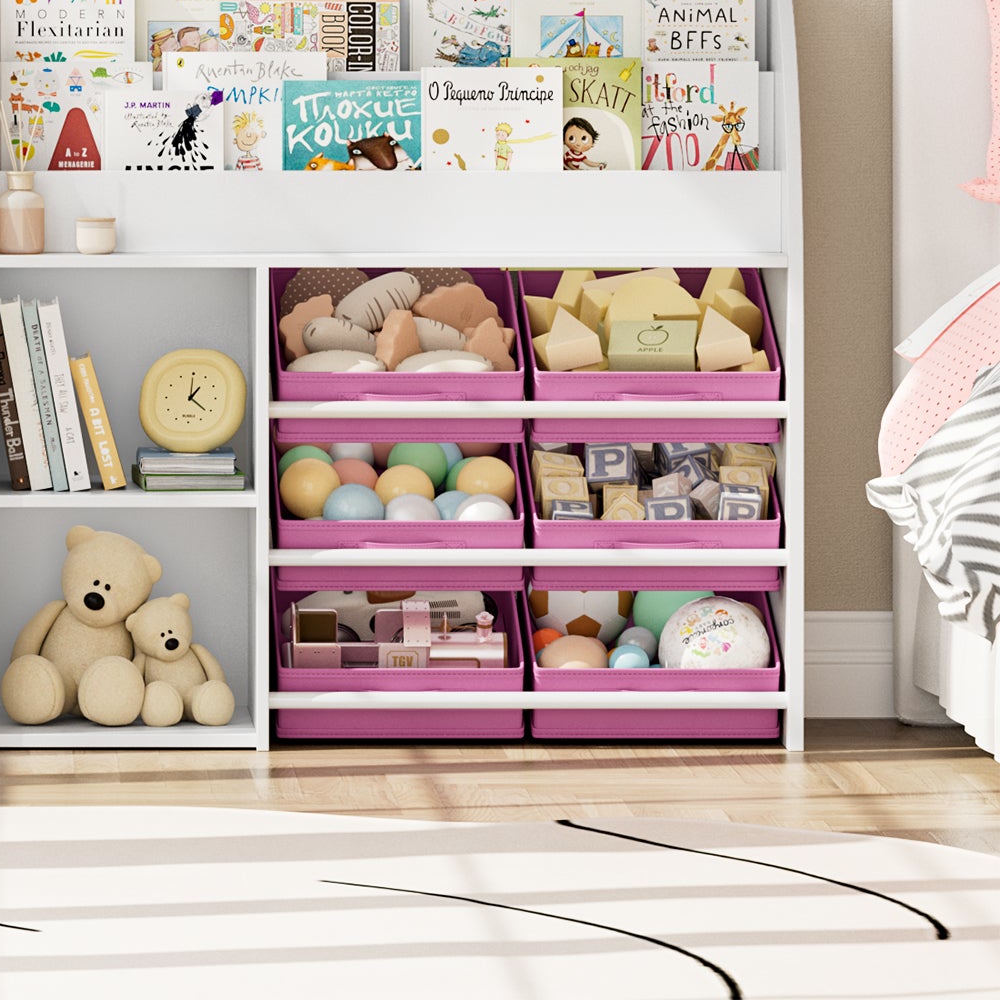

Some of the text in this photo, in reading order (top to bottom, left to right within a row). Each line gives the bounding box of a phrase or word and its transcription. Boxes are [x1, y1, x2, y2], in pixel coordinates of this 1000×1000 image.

[16, 9, 125, 19] MODERN
[17, 21, 124, 38] Flexitarian
[321, 15, 346, 56] BOOK
[196, 59, 303, 83] Quentin Blake
[569, 63, 583, 72] och
[581, 64, 599, 77] jag
[207, 85, 282, 104] MPKI
[429, 81, 439, 100] O
[443, 81, 494, 106] Pequeno
[569, 78, 636, 113] SKATT
[661, 102, 683, 115] the
[647, 110, 709, 142] fashion
[65, 147, 72, 157] A
[82, 147, 87, 157] Z
[31, 324, 42, 352] DEATH
[0, 388, 20, 438] Thunder
[6, 438, 24, 461] Ball
[98, 441, 113, 468] LOST
[591, 449, 625, 476] P
[726, 503, 756, 520] P
[391, 655, 414, 667] TGV
